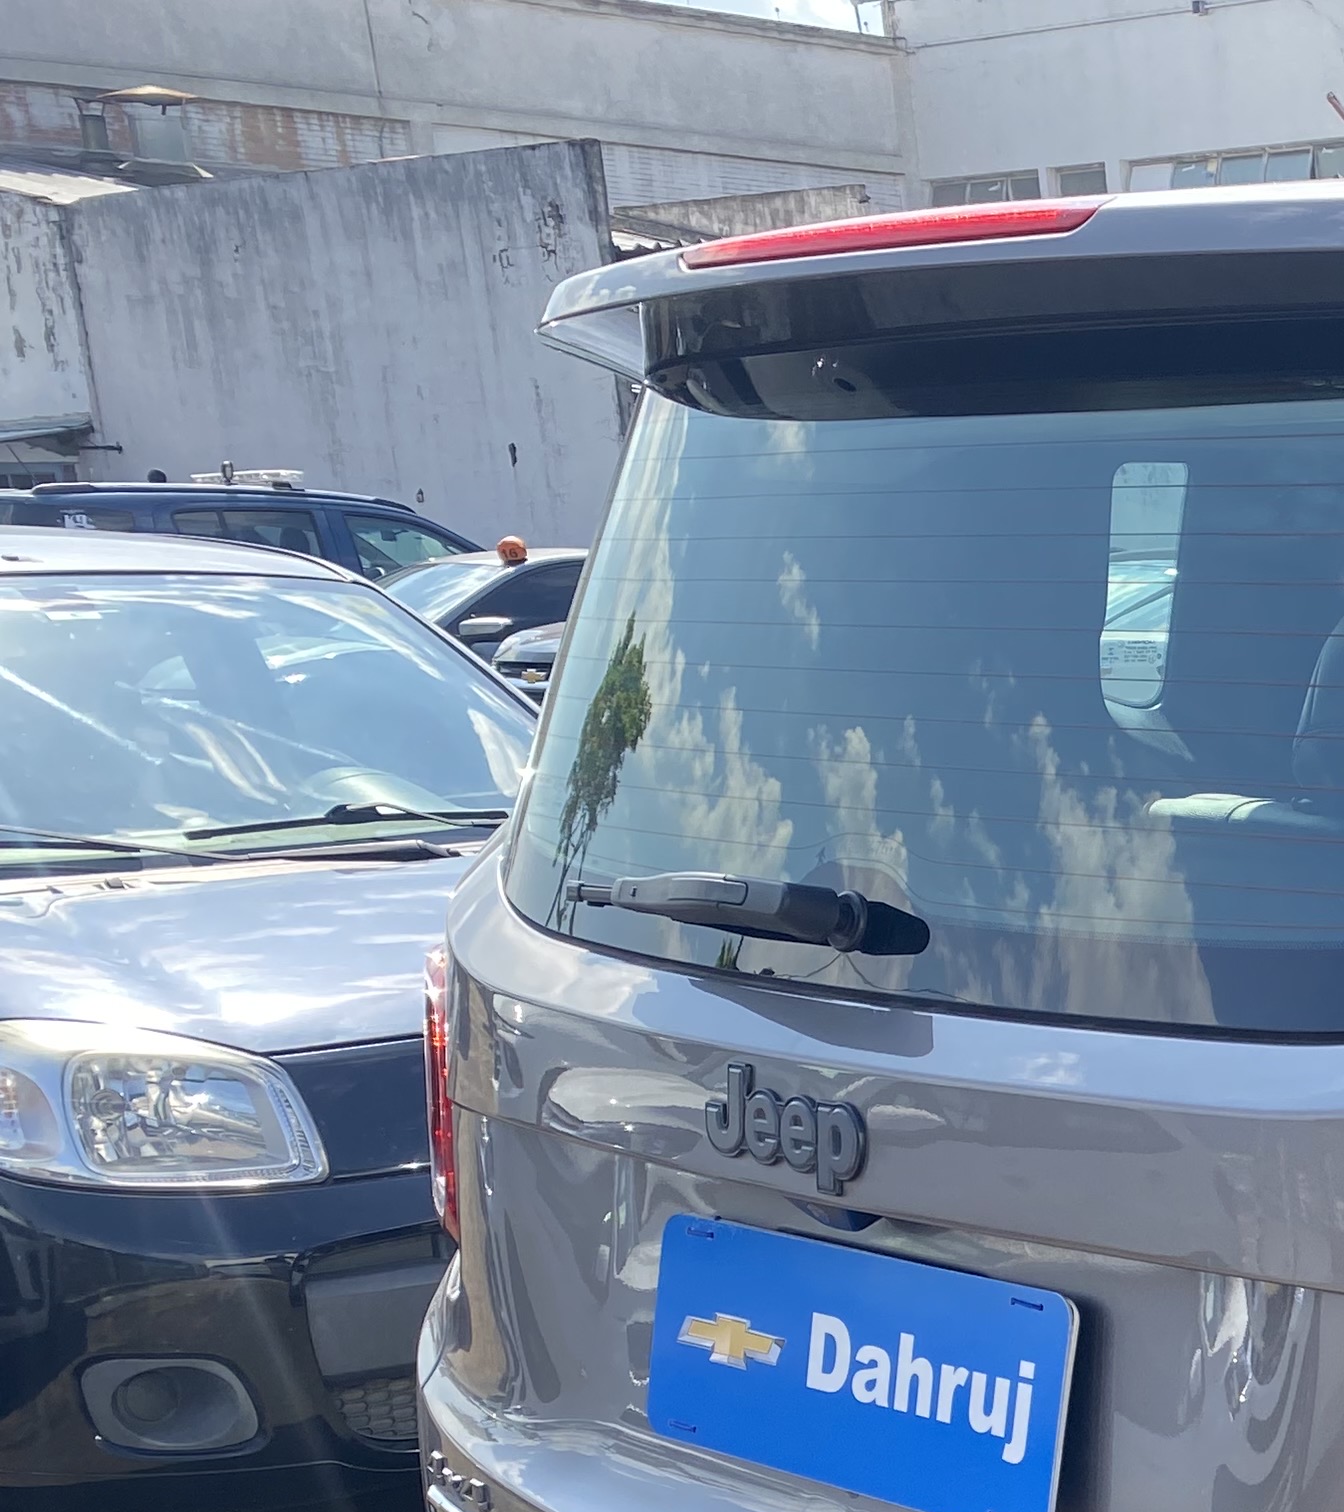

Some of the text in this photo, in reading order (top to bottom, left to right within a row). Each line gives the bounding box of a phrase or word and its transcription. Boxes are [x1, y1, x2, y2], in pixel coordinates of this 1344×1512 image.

[501, 548, 518, 559] 16
[705, 1061, 866, 1197] Jeep
[805, 1311, 1036, 1465] Dahruj
